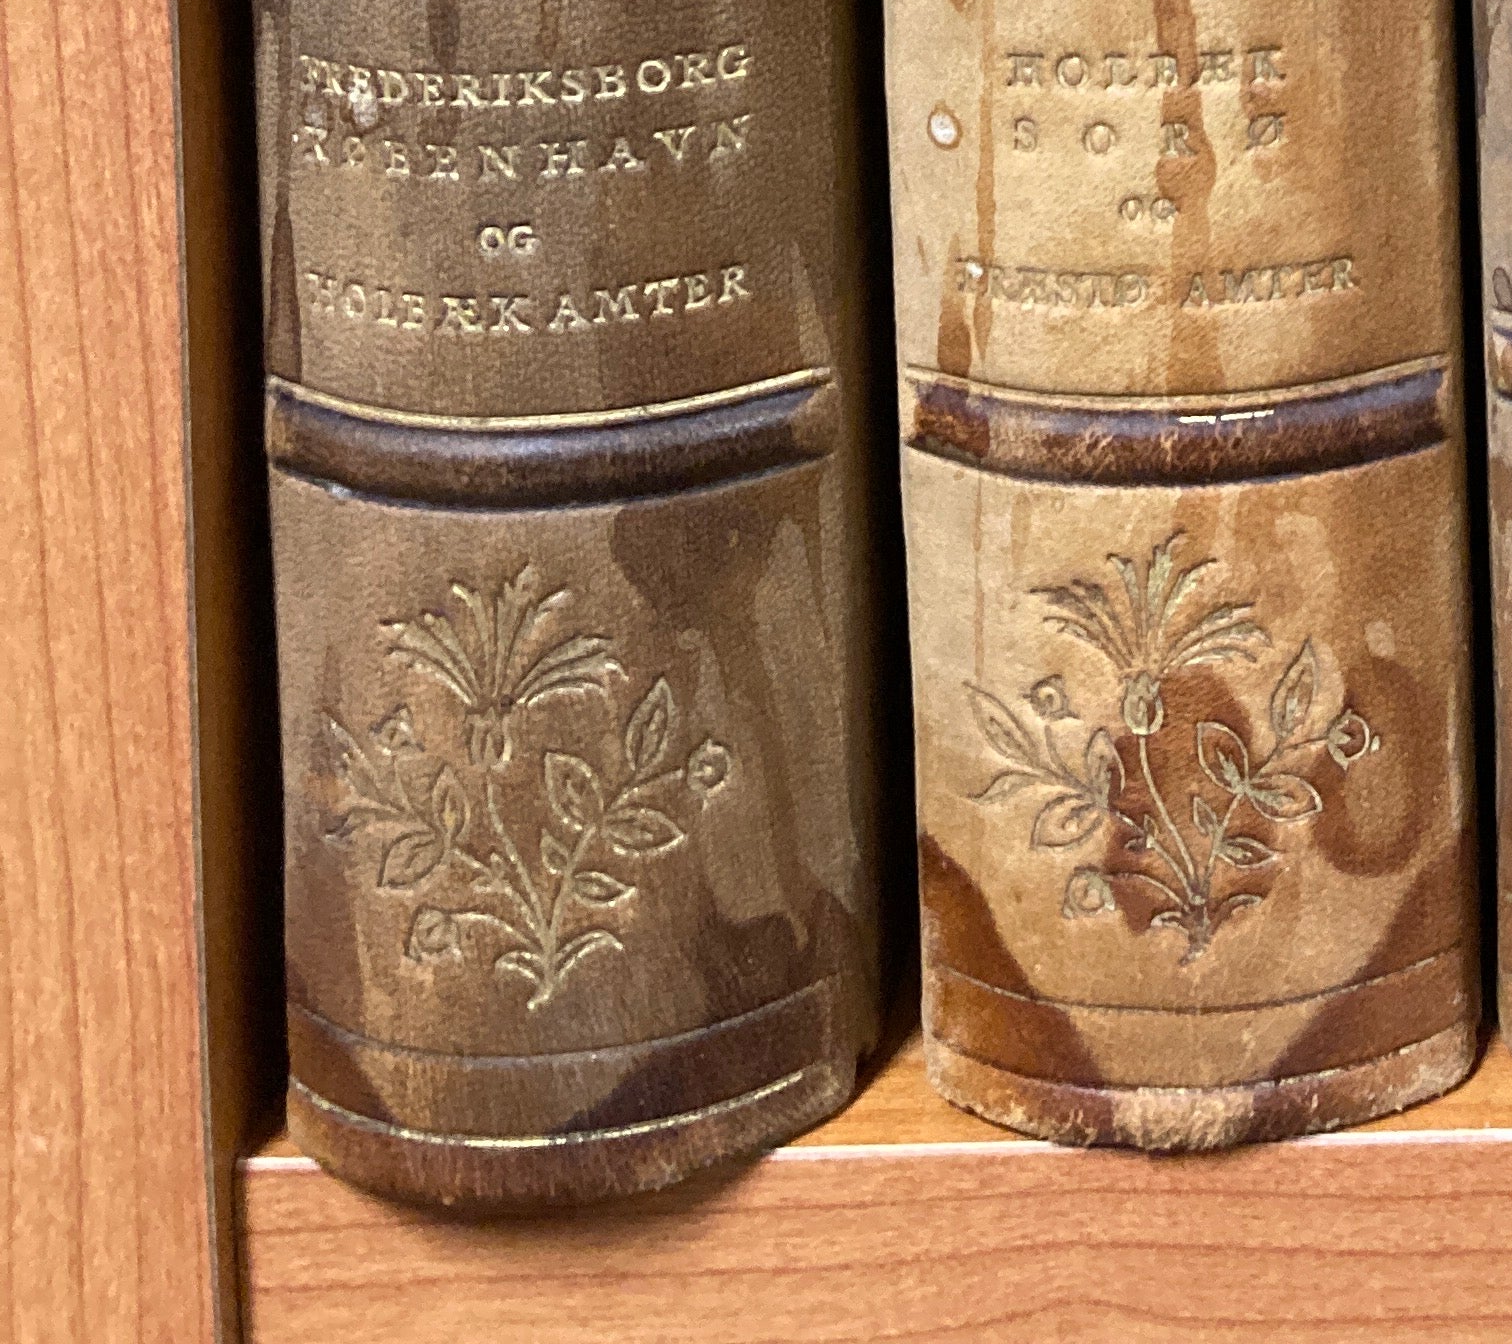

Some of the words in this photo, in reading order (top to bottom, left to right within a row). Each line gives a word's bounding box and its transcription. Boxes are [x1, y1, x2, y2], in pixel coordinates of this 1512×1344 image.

[1014, 112, 1285, 156] SORØ
[1119, 196, 1177, 223] OG
[478, 224, 538, 257] OG
[549, 264, 751, 332] AMTER
[1180, 257, 1358, 309] AMTER
